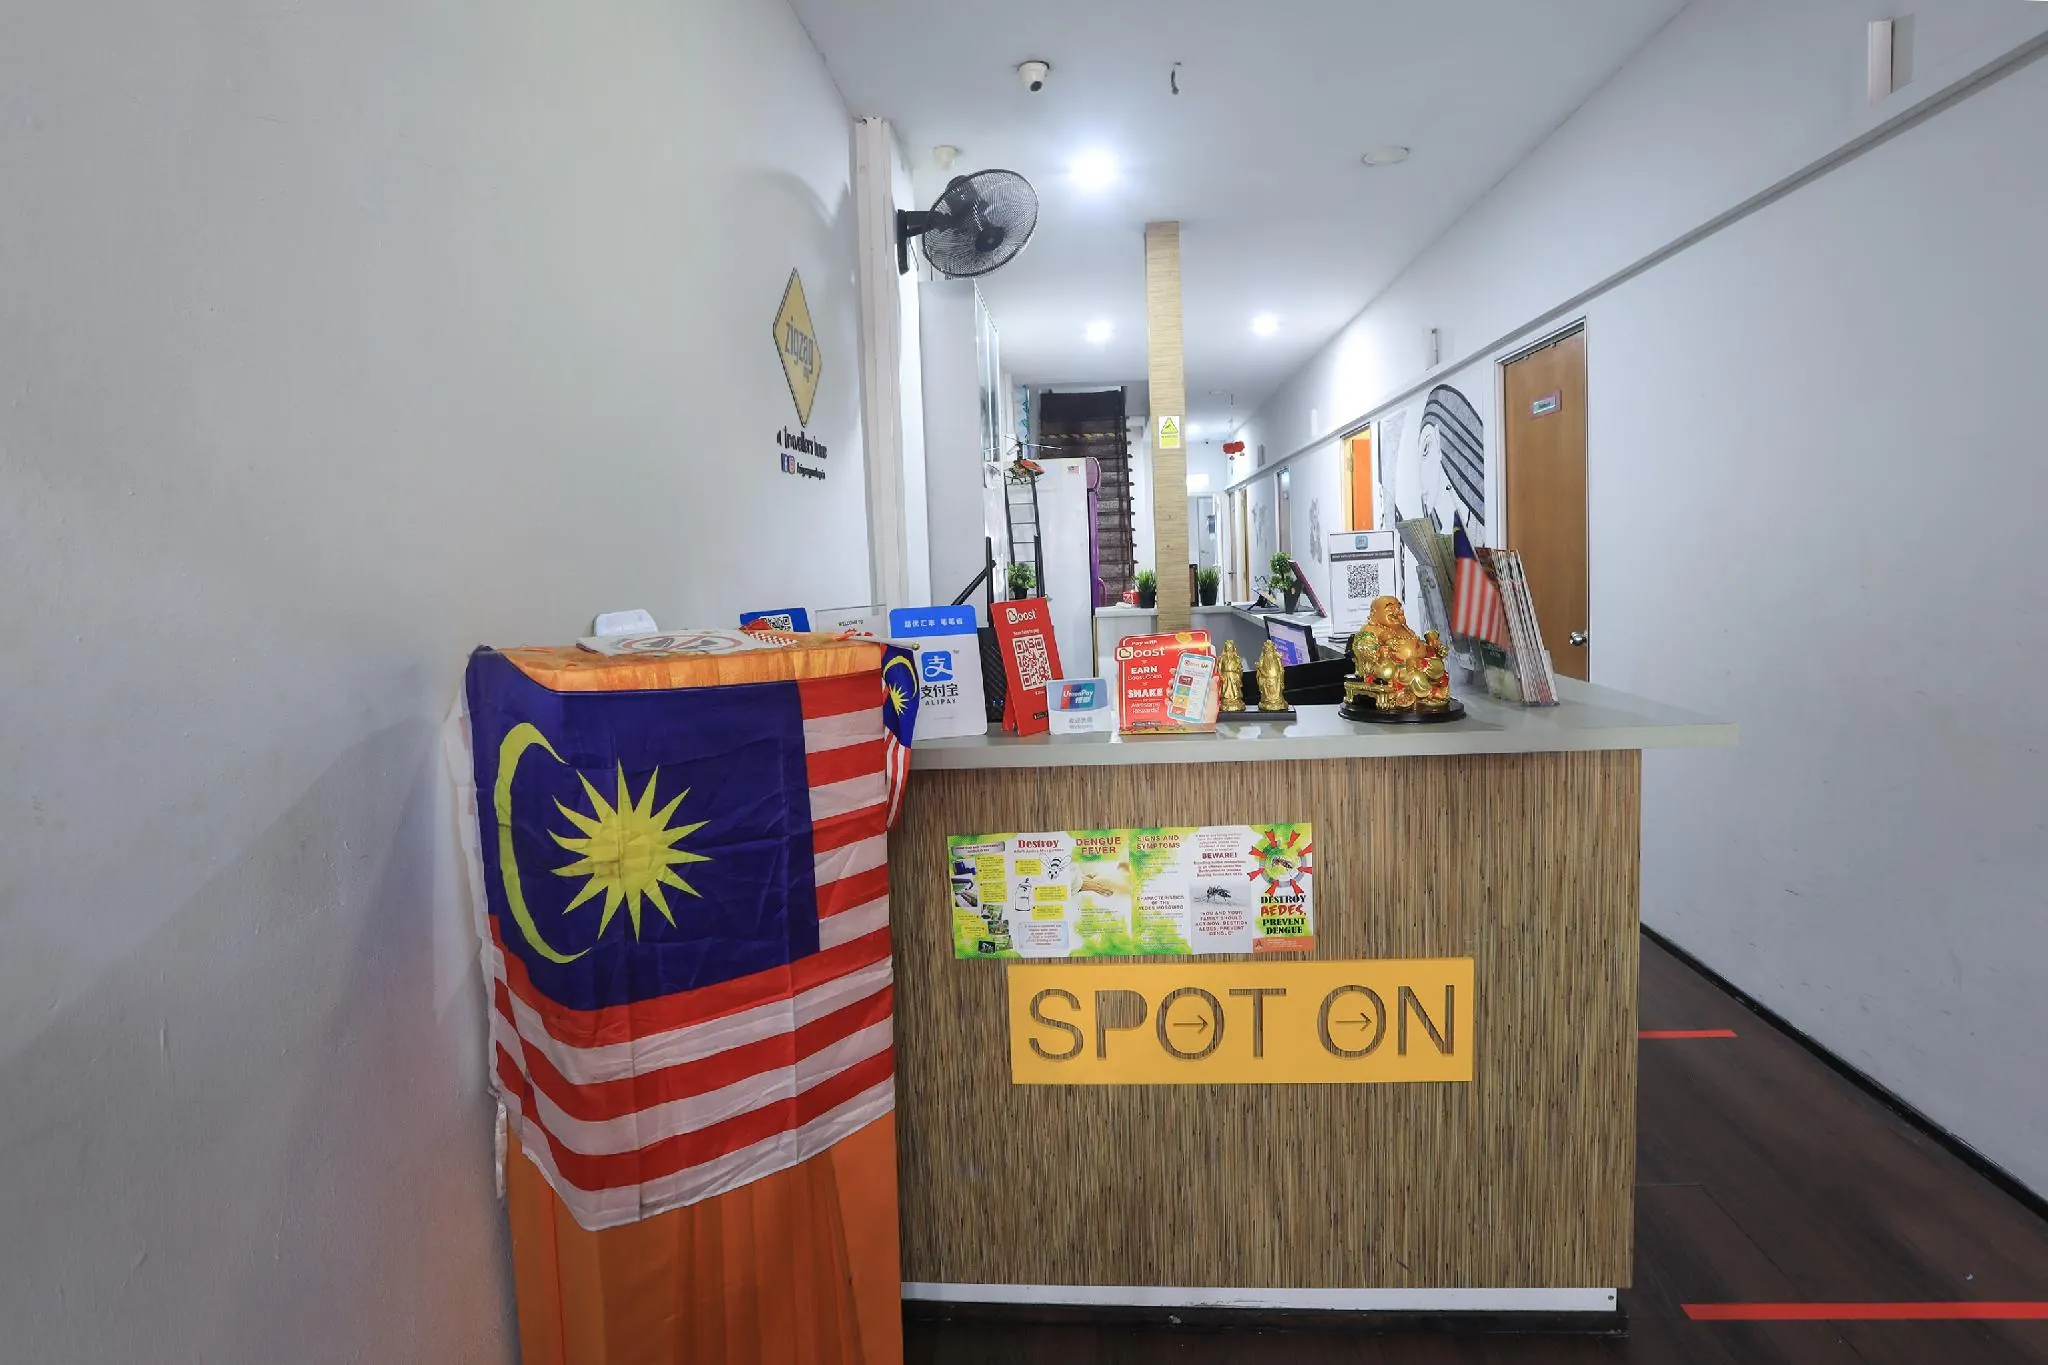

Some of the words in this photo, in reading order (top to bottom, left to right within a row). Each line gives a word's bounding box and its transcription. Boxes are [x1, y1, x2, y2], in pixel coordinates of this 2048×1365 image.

[1131, 666, 1158, 674] EARN
[921, 683, 959, 700] 支付宝
[1063, 688, 1094, 698] UnionPay
[1127, 688, 1164, 698] SHAKE
[925, 698, 957, 706] ALIPAY
[1017, 839, 1059, 848] Destroy
[1076, 836, 1121, 846] DENGUE
[1081, 846, 1117, 855] FEVER
[1260, 895, 1307, 904] DESTROY
[1262, 917, 1306, 926] PREVENT
[1266, 926, 1303, 935] DENGUE
[1028, 985, 1287, 1062] SPOT
[1316, 984, 1456, 1060] ON
